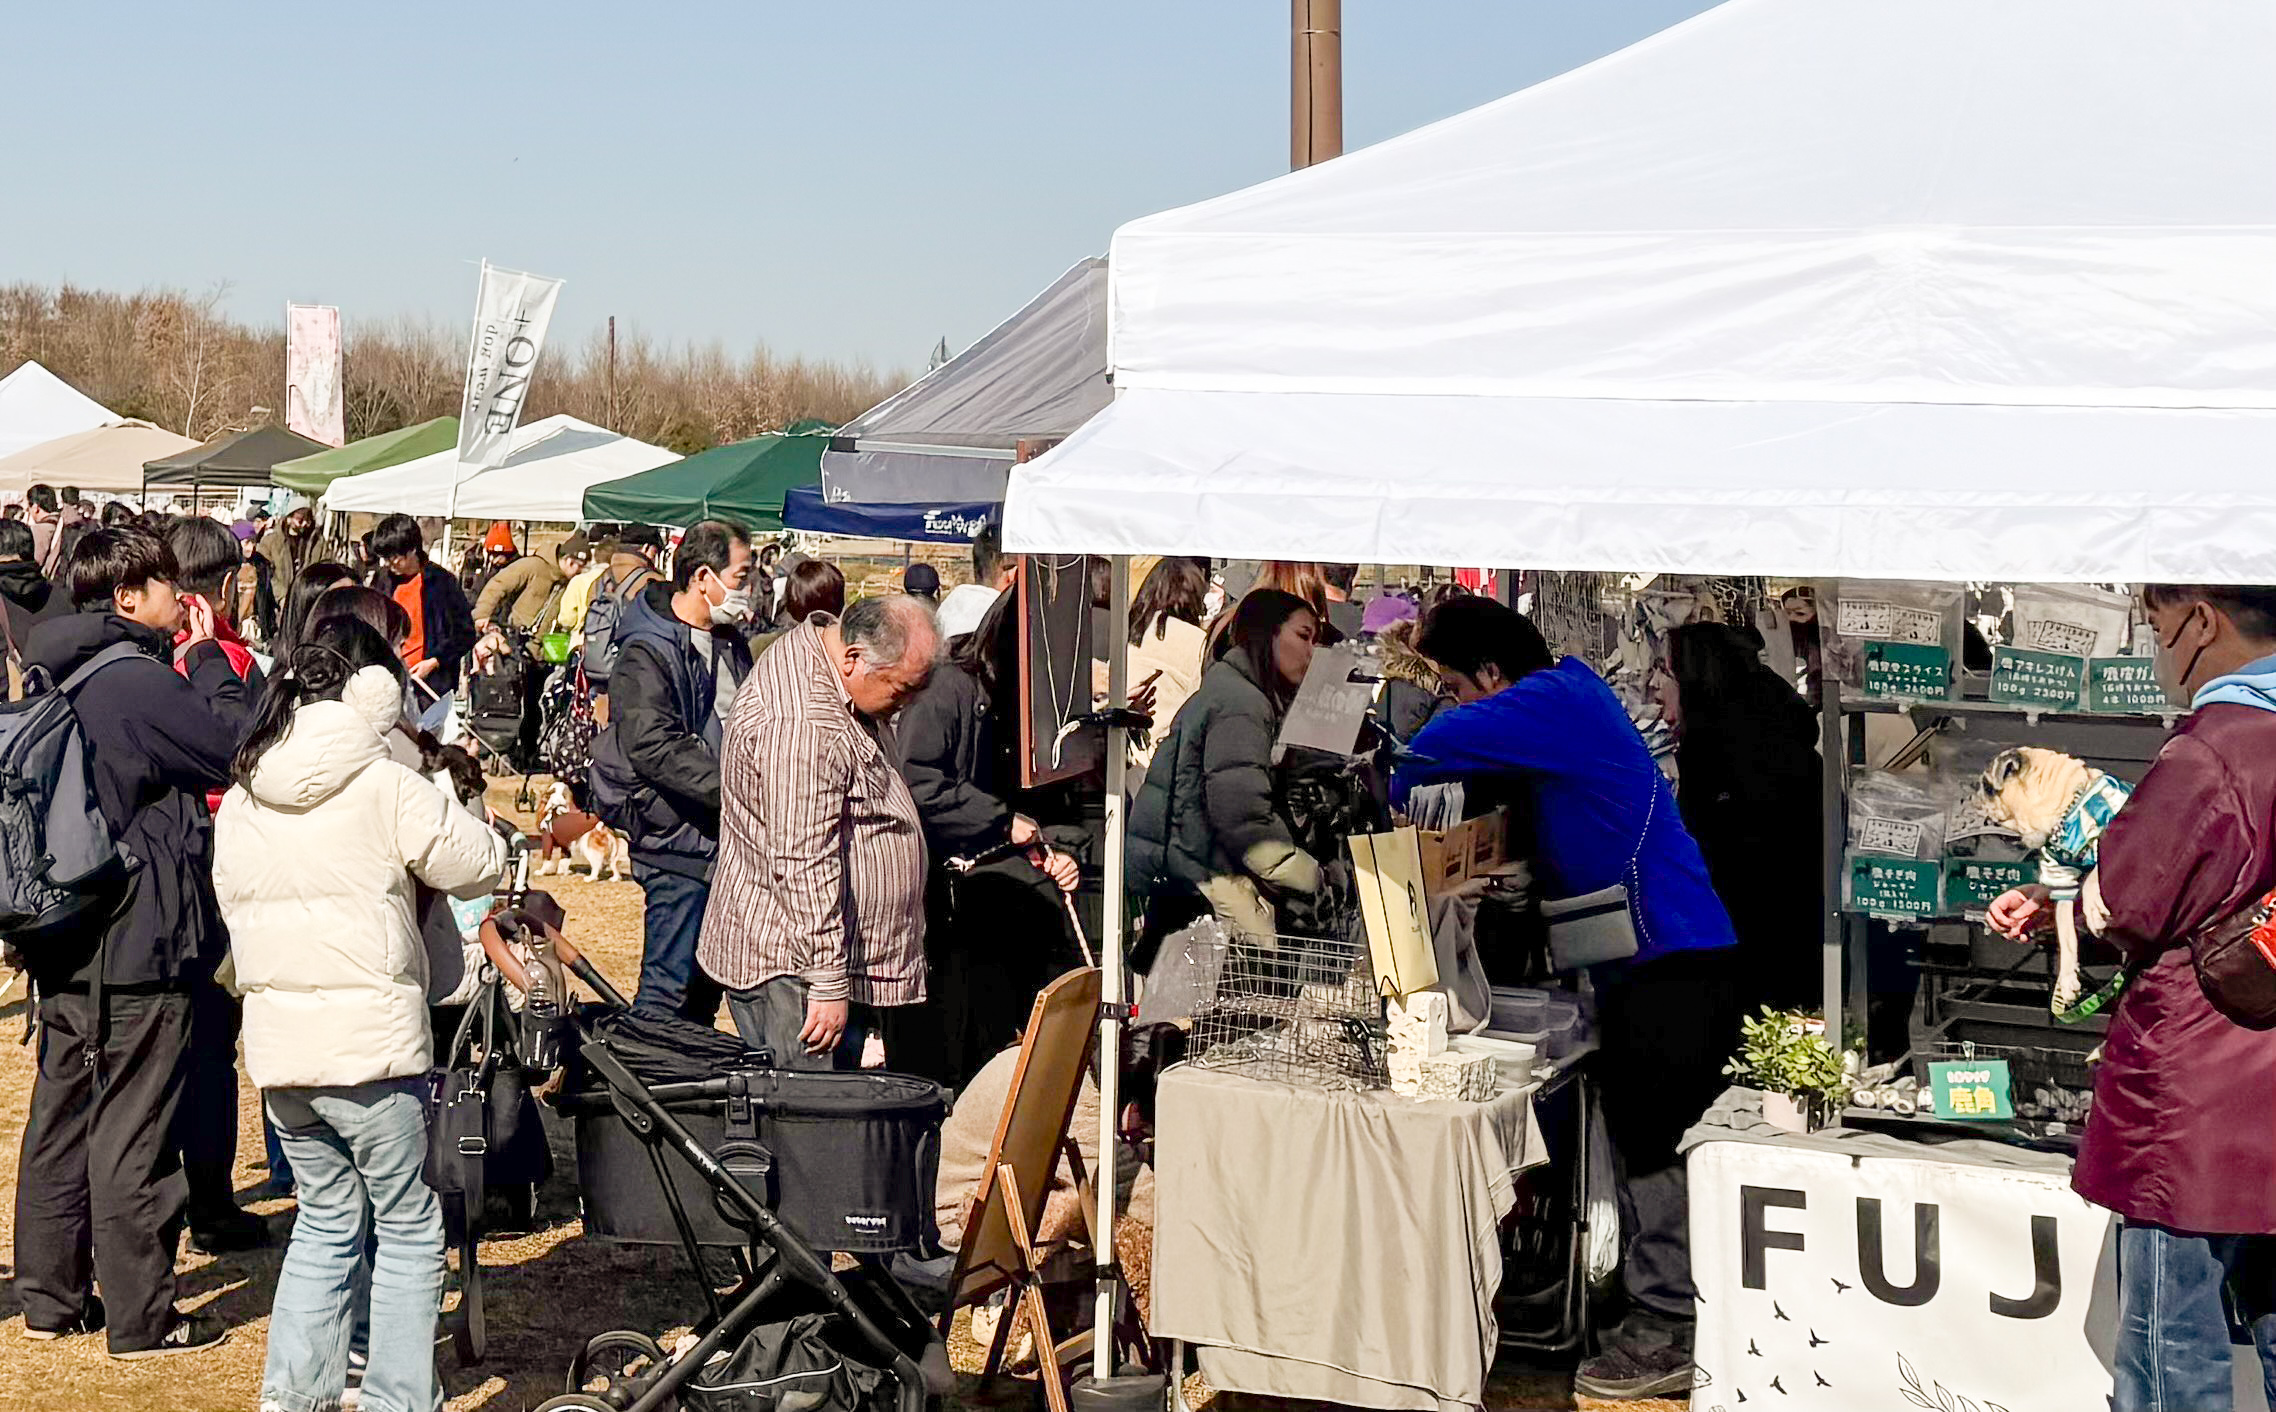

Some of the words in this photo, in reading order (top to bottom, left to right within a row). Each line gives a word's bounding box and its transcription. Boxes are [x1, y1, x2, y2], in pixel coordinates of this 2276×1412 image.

[480, 324, 497, 359] dog
[471, 367, 488, 413] wear
[1949, 1086, 1996, 1114] 鹿角
